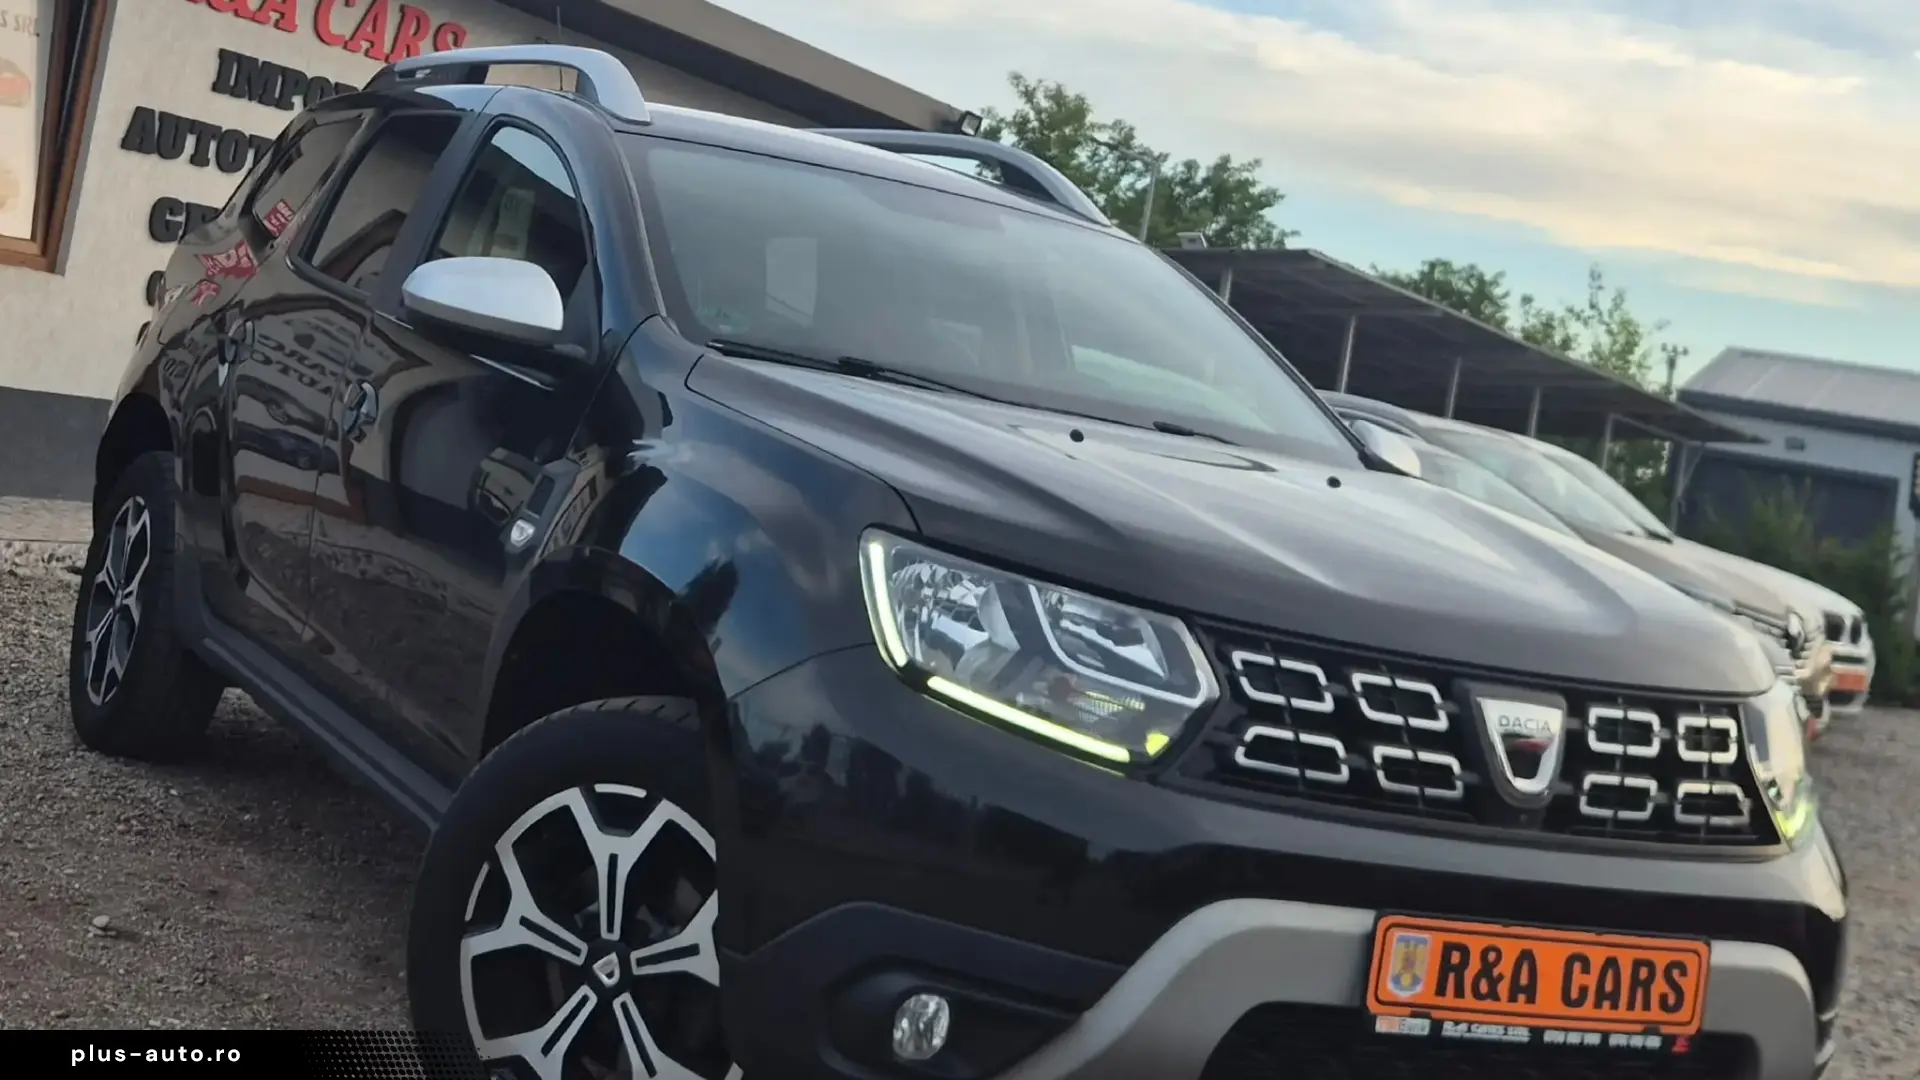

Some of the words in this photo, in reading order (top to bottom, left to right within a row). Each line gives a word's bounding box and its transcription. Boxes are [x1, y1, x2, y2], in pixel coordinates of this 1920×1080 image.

[1498, 715, 1552, 733] DACIA
[1434, 941, 1538, 1005] R&A
[1561, 952, 1689, 1014] CARS
